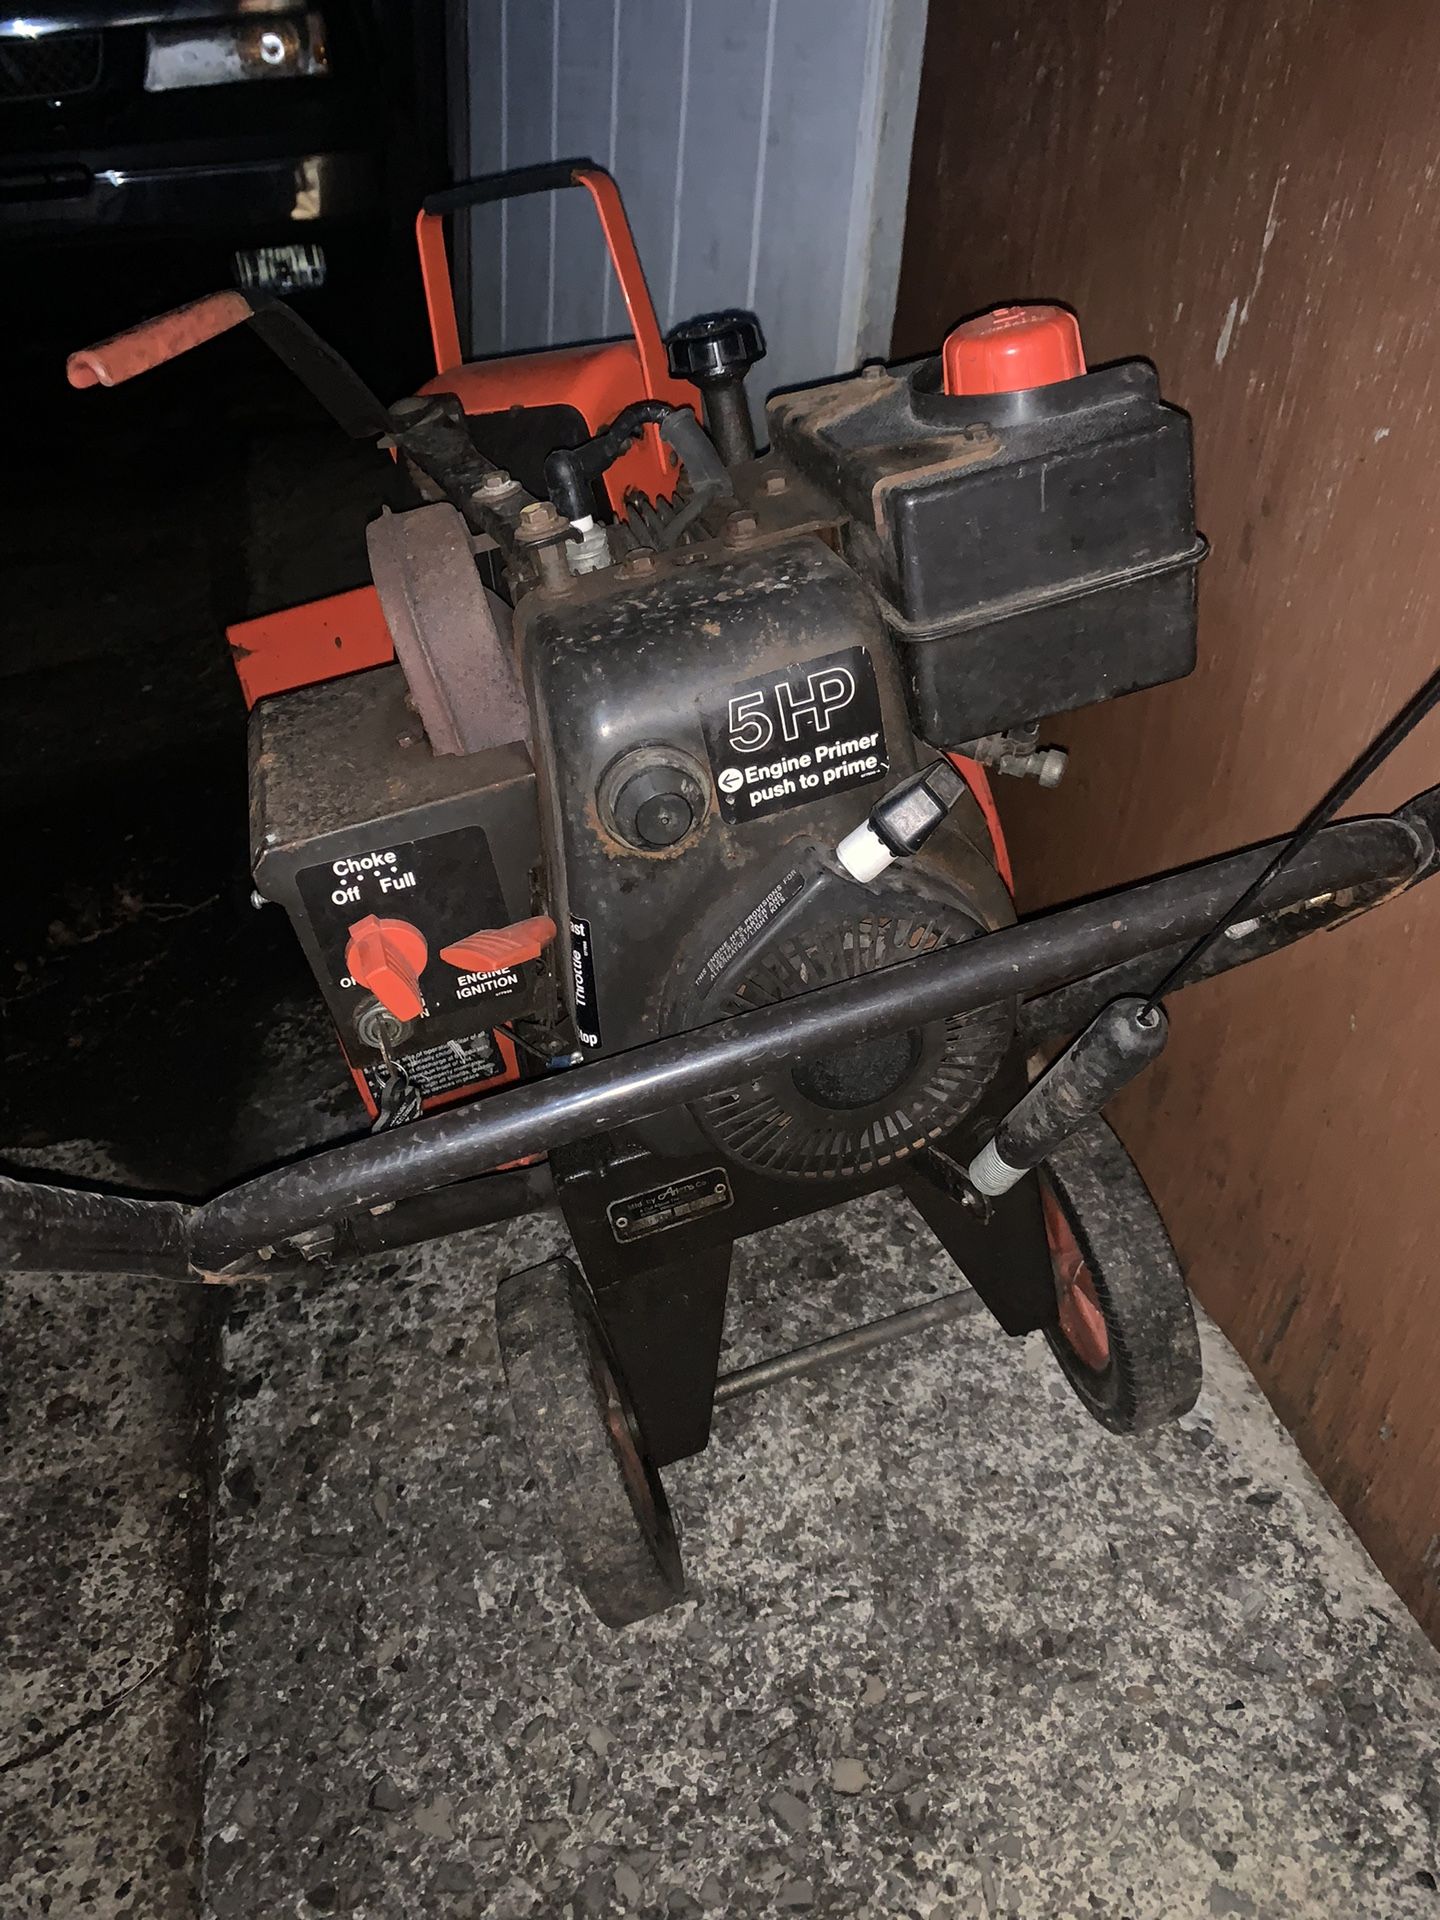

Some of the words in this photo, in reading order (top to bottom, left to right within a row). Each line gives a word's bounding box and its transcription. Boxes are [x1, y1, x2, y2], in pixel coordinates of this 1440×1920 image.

[745, 755, 812, 784] Engine
[815, 732, 879, 763] Primer
[750, 779, 796, 807] push
[800, 774, 820, 790] to
[823, 756, 878, 784] prime
[332, 852, 397, 876] Choke
[331, 886, 361, 906] Off
[379, 872, 416, 894] Full
[695, 969, 707, 985] THIS
[730, 926, 743, 941] HAS
[744, 884, 782, 925] PROVISIONS
[783, 870, 797, 884] FOR
[739, 910, 767, 939] STARTER
[768, 892, 782, 908] AND
[456, 974, 518, 1000] IGNITION
[572, 950, 586, 1006] Throttle
[579, 1029, 598, 1047] top
